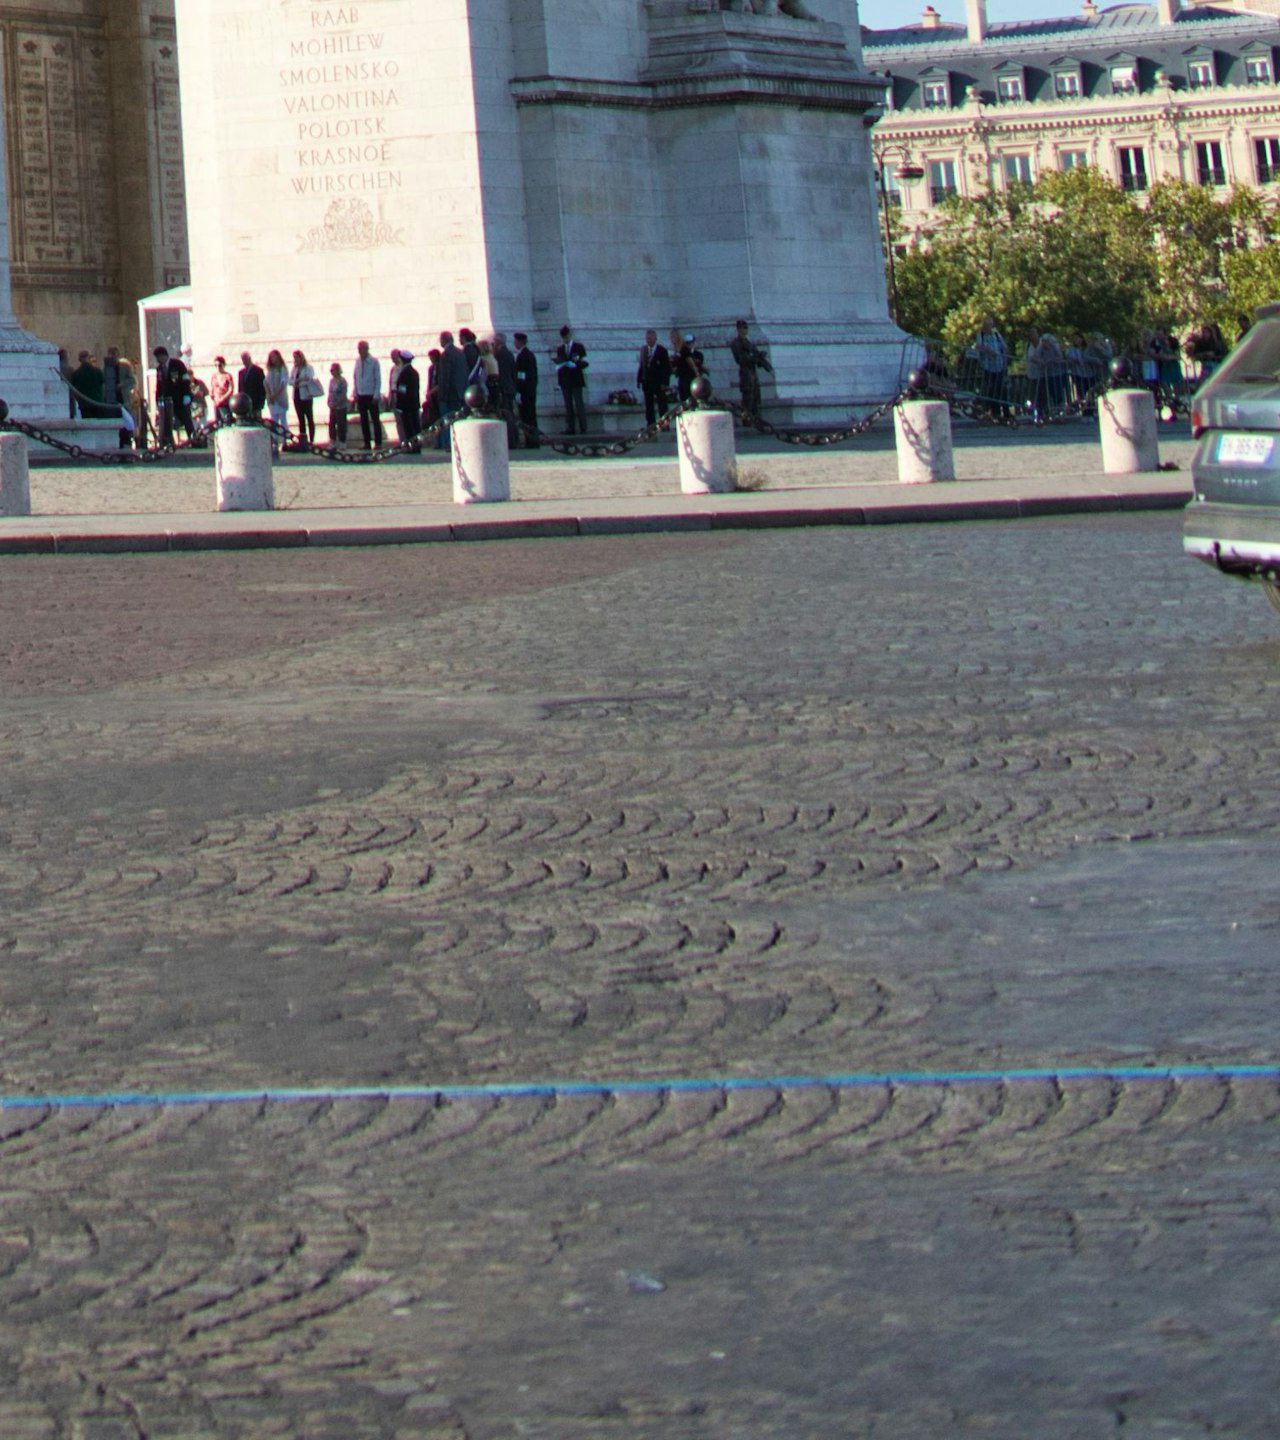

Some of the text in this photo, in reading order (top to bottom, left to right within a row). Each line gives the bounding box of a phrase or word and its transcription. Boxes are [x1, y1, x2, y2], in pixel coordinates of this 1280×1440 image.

[311, 8, 359, 27] RAAB
[291, 33, 384, 57] MOHILEW
[280, 61, 399, 87] SMOLENSKO
[284, 89, 399, 114] VALONTINA
[299, 118, 386, 140] POLOTSK
[299, 143, 392, 167] KRASNOE
[291, 171, 402, 194] WURSCHEN
